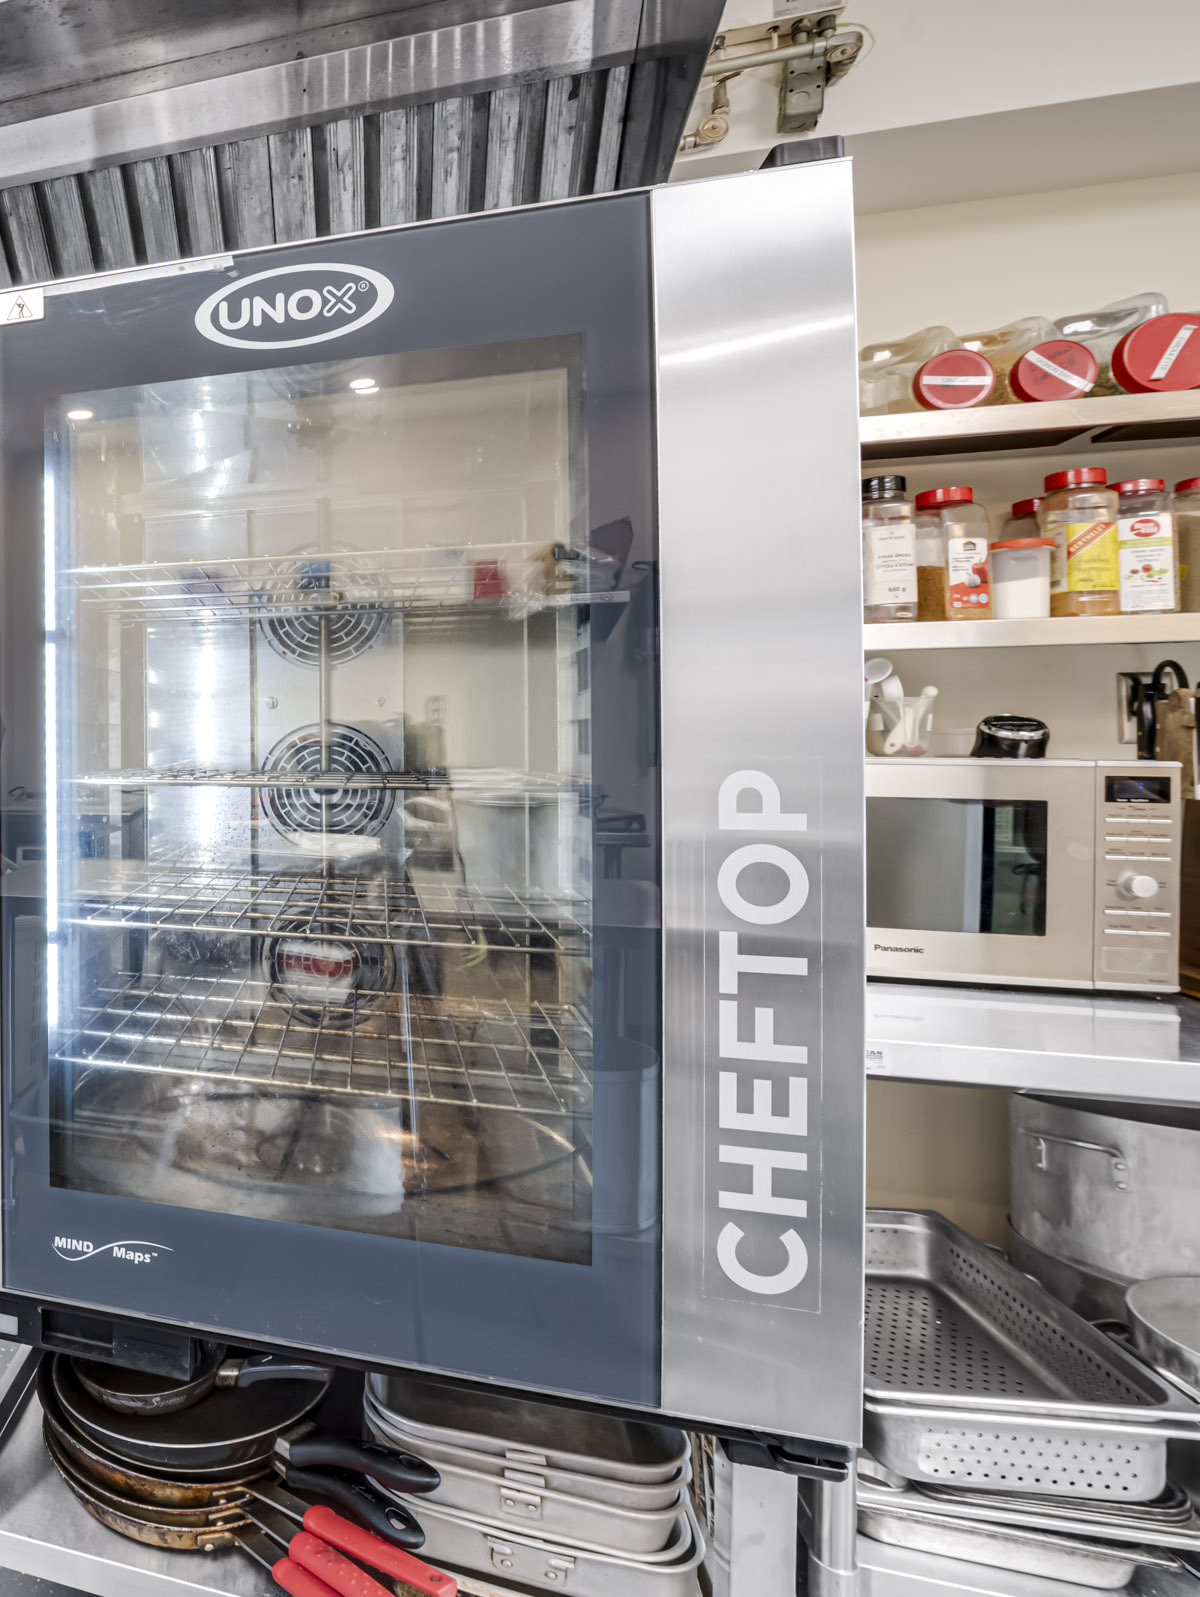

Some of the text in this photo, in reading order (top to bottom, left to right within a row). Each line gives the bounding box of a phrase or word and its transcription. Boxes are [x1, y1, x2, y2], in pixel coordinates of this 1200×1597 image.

[874, 944, 925, 954] Panasonic
[717, 770, 809, 1295] CHEFTOP
[54, 1235, 94, 1253] MIND
